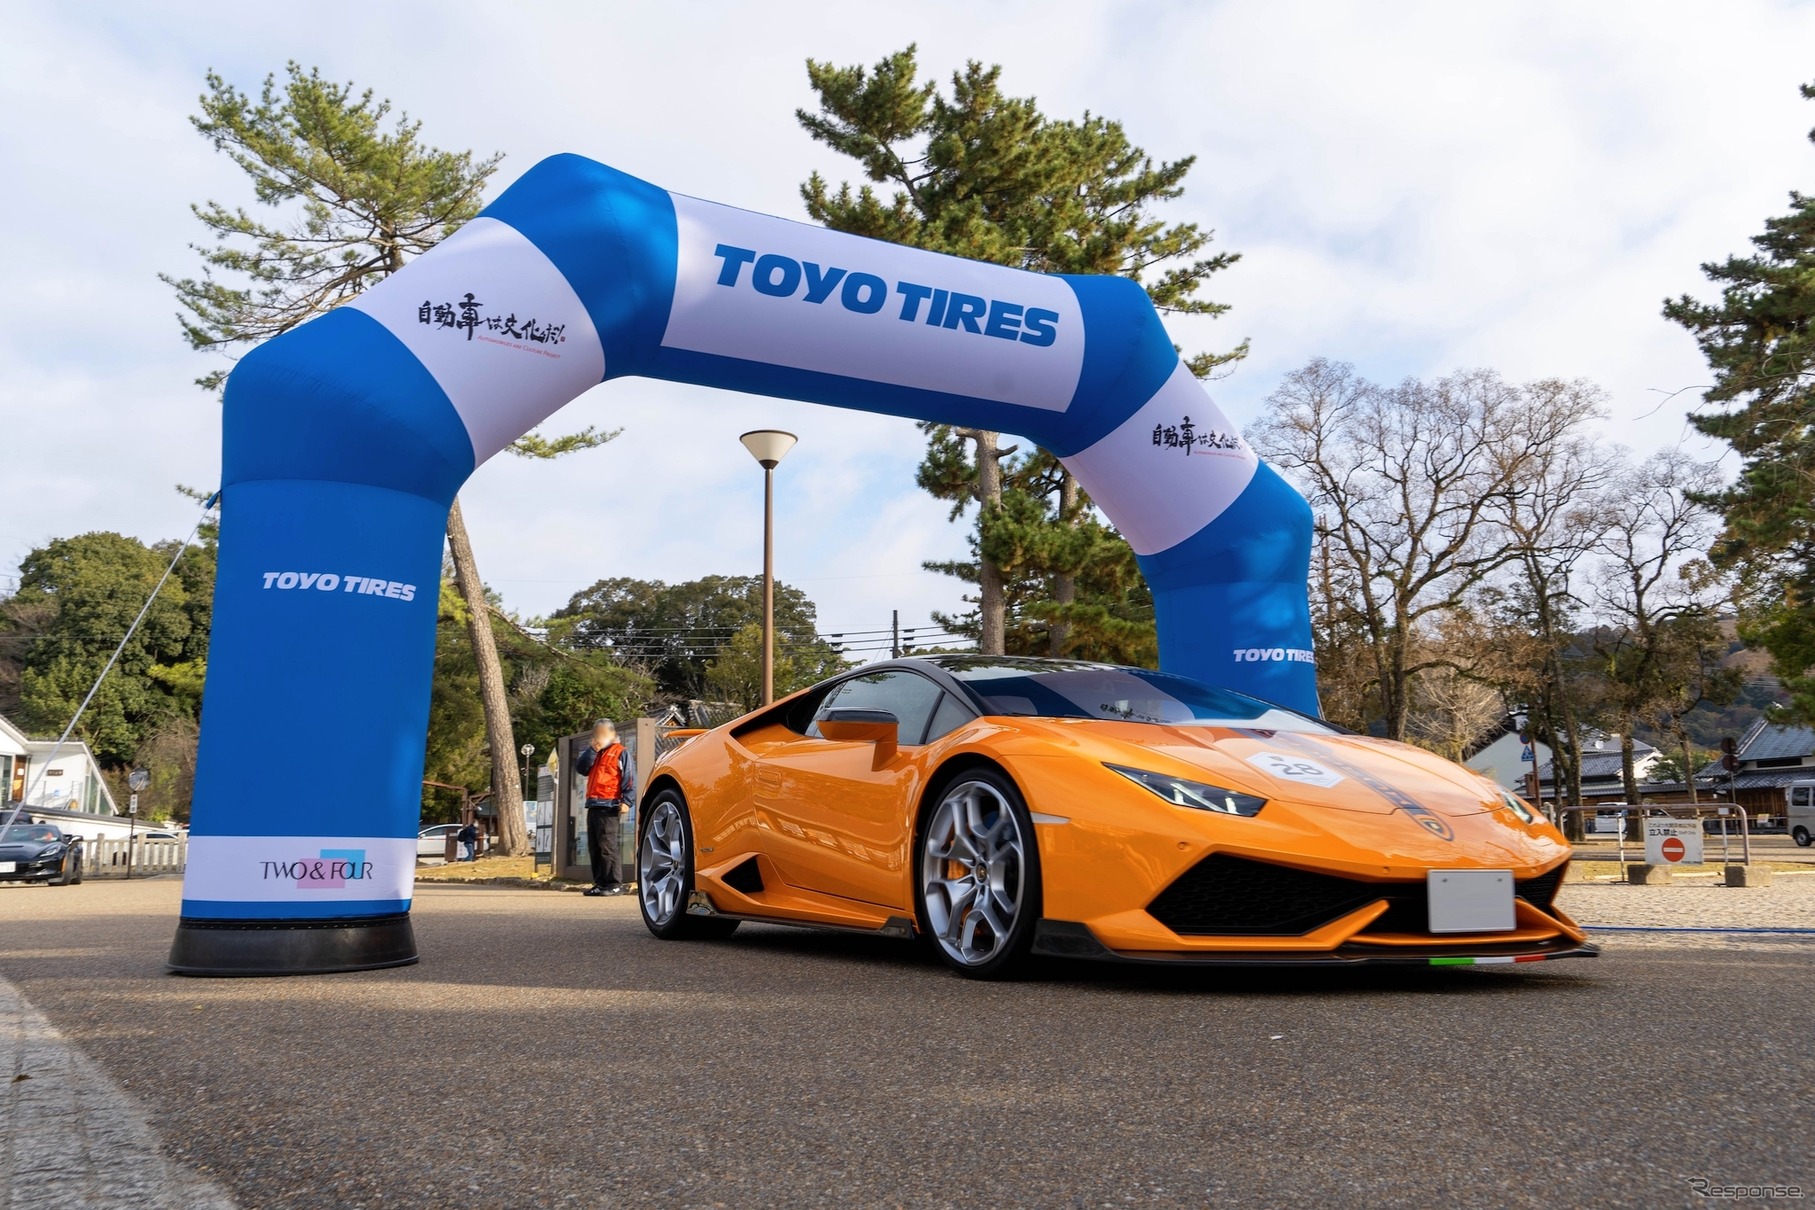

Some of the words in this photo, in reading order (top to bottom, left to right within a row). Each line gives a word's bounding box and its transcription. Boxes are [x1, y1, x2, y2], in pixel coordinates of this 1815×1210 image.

[714, 243, 888, 314] TOYO
[896, 281, 1060, 348] TIRES
[263, 571, 340, 592] TOYO
[343, 575, 417, 602] TIRES
[1233, 648, 1285, 662] TOYO
[1270, 763, 1324, 775] 28
[259, 861, 308, 880] TWO
[309, 861, 327, 880] &
[330, 861, 374, 880] FOUR
